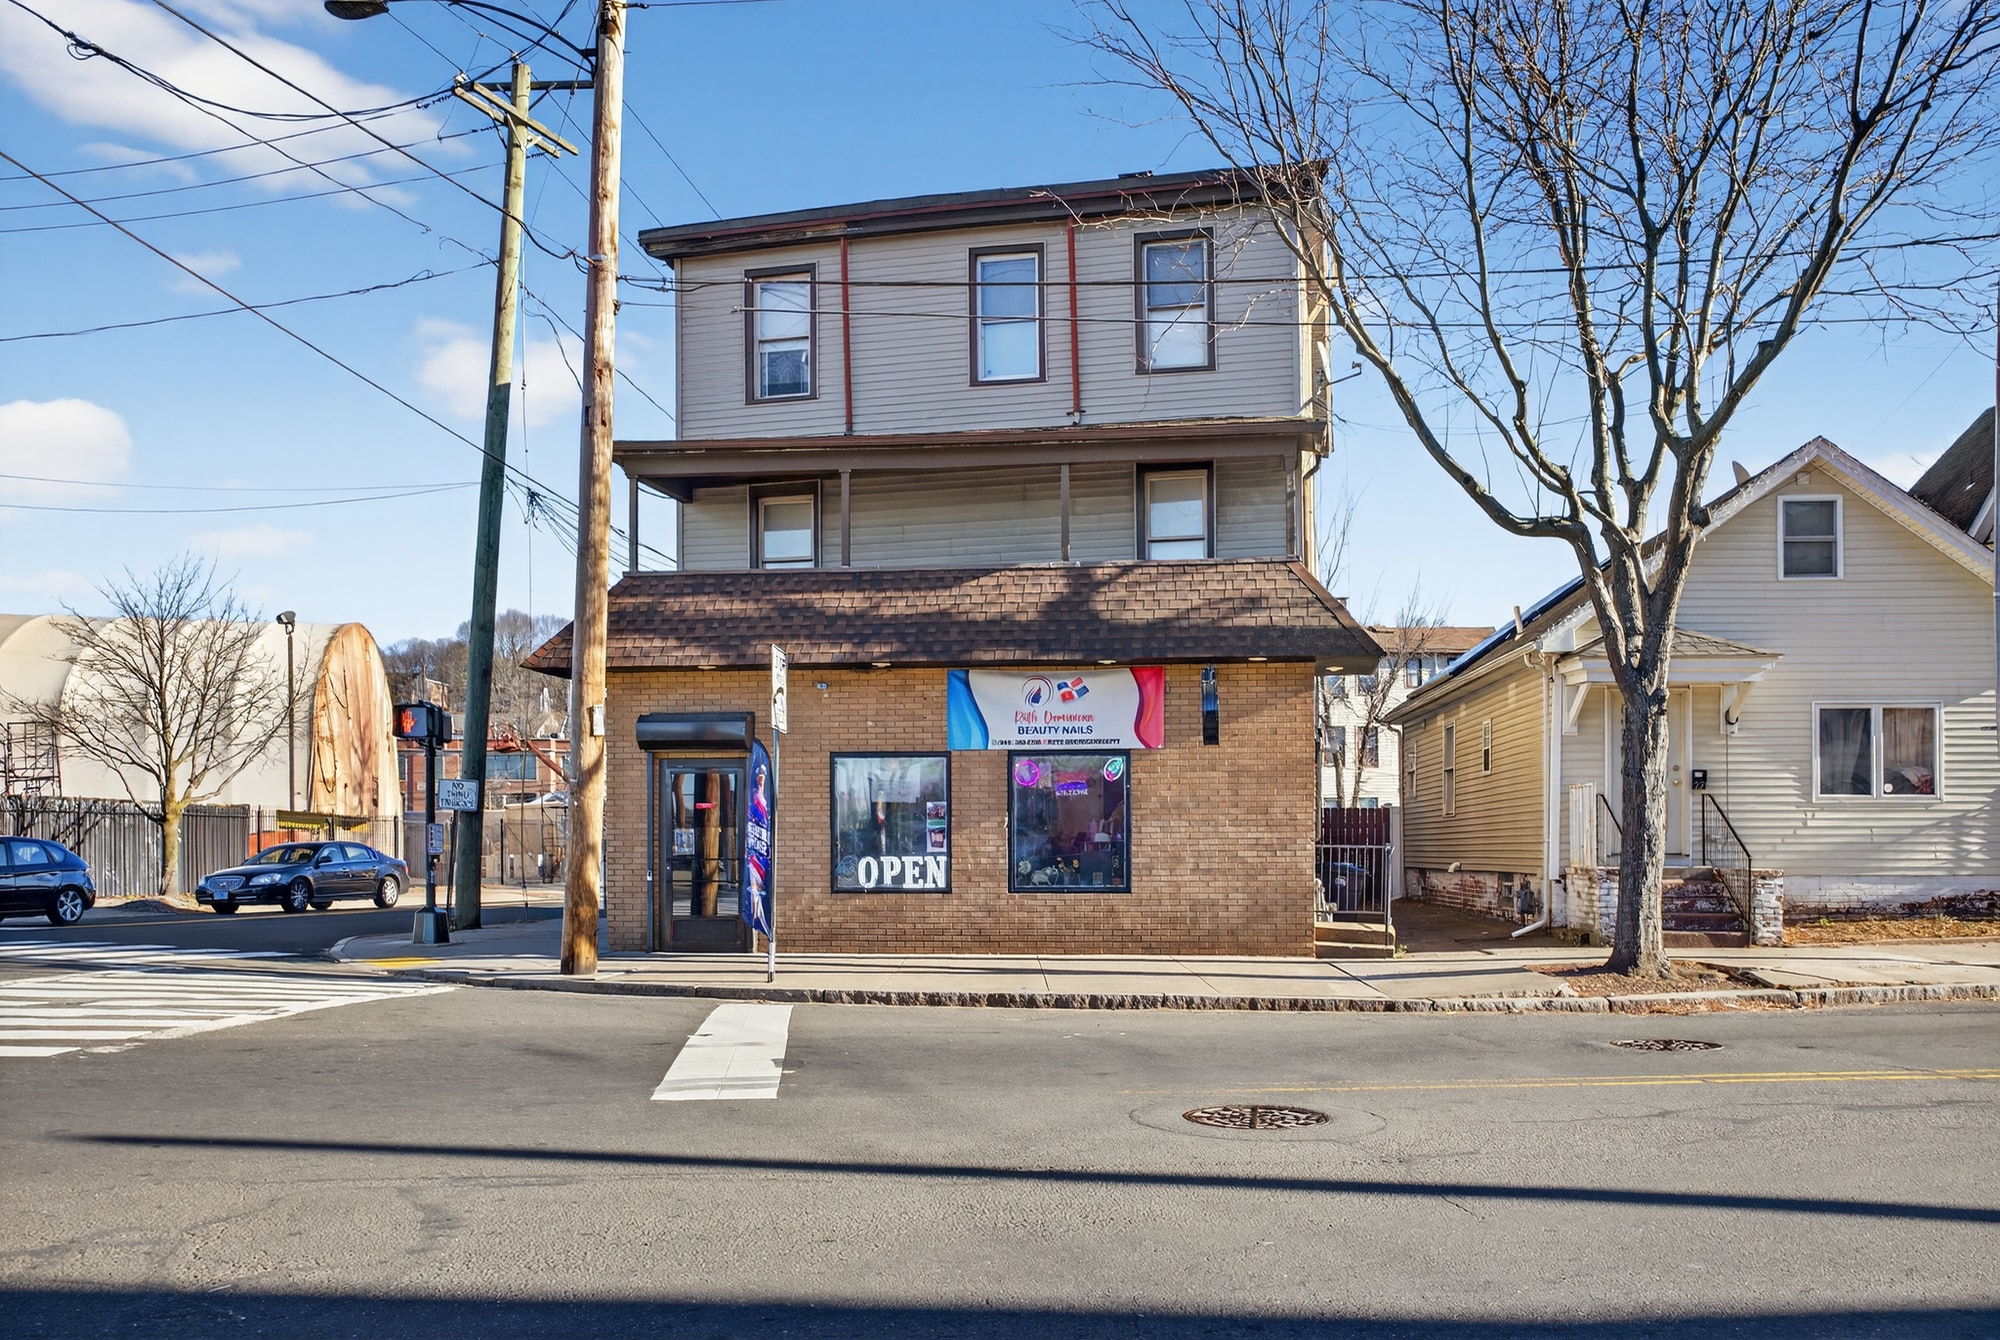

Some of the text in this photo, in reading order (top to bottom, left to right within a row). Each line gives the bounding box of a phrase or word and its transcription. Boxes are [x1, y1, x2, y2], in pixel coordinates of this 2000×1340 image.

[1018, 725, 1093, 735] BEAUTY NAILS
[858, 855, 947, 888] OPEN
